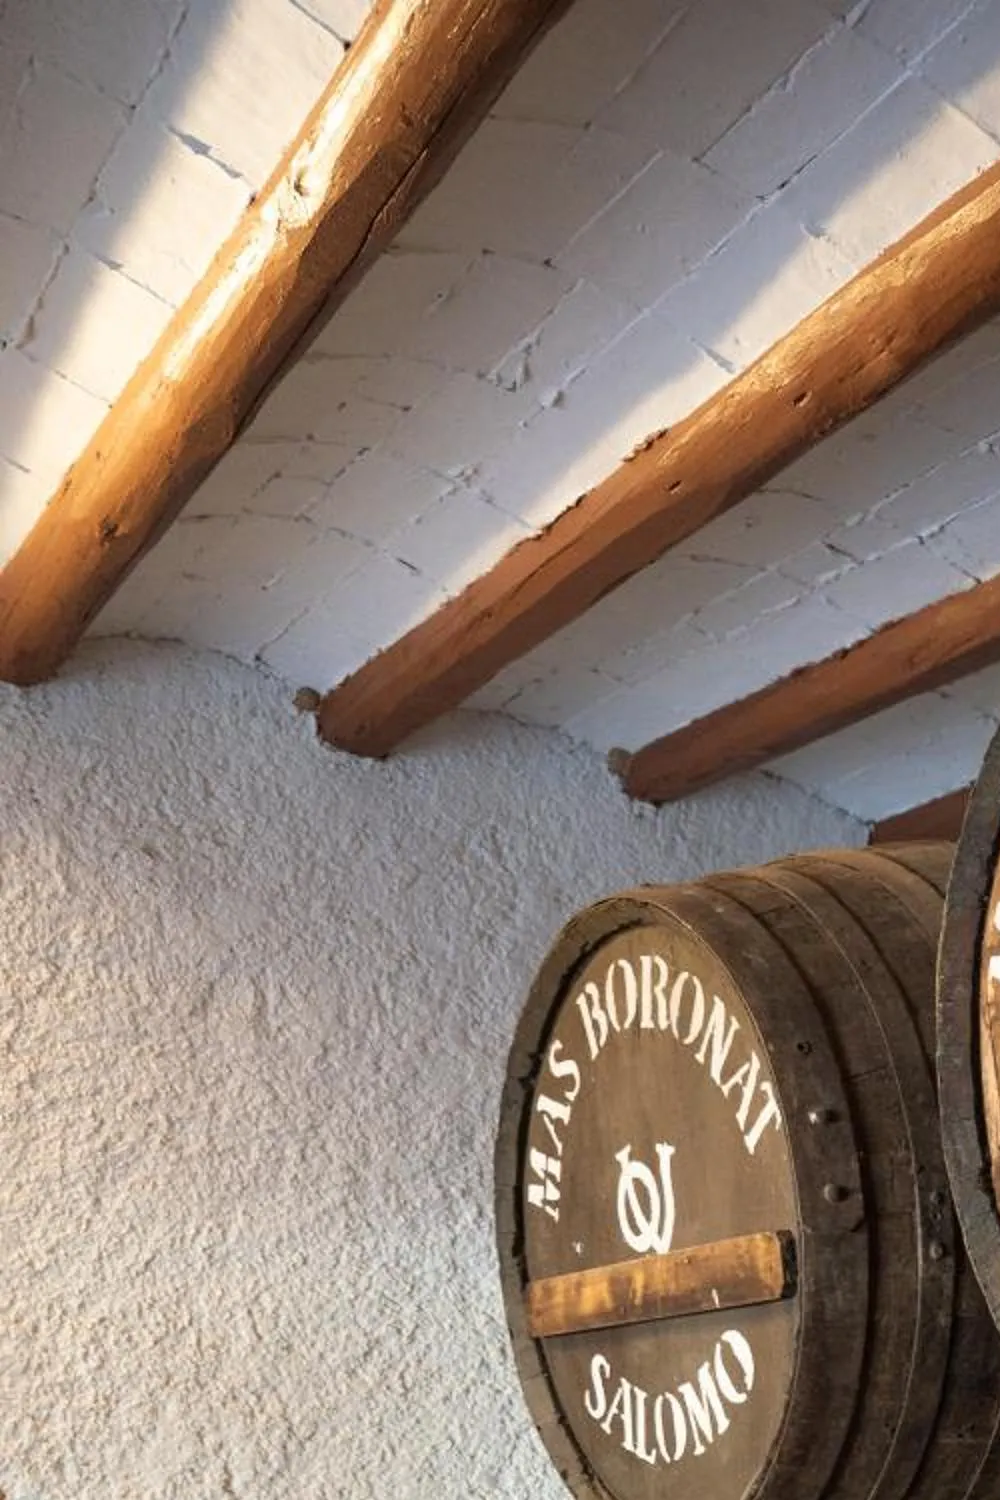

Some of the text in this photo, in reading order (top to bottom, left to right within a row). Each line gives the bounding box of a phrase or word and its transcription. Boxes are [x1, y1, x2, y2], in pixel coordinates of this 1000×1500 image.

[528, 955, 782, 1221] MAS BORONAT
[583, 1328, 756, 1467] SALOMO
